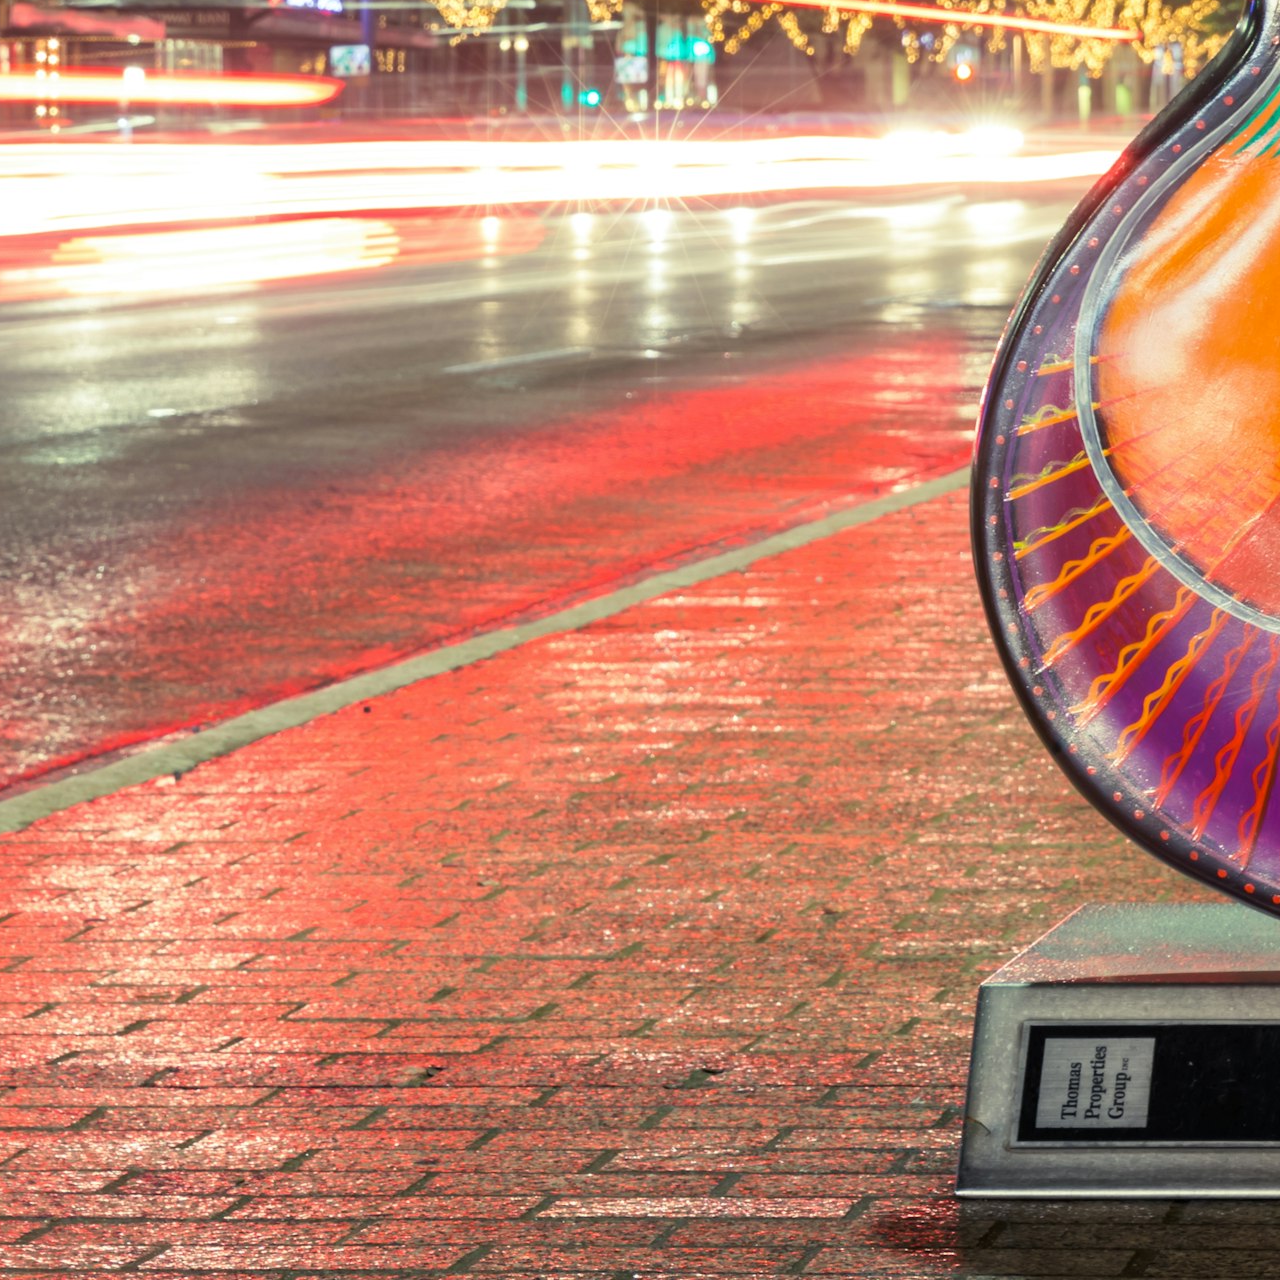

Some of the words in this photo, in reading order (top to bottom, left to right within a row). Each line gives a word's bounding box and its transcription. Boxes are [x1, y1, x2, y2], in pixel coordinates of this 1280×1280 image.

[1061, 1061, 1082, 1120] Thomas
[1084, 1045, 1107, 1120] Properties
[1107, 1072, 1131, 1120] Group
